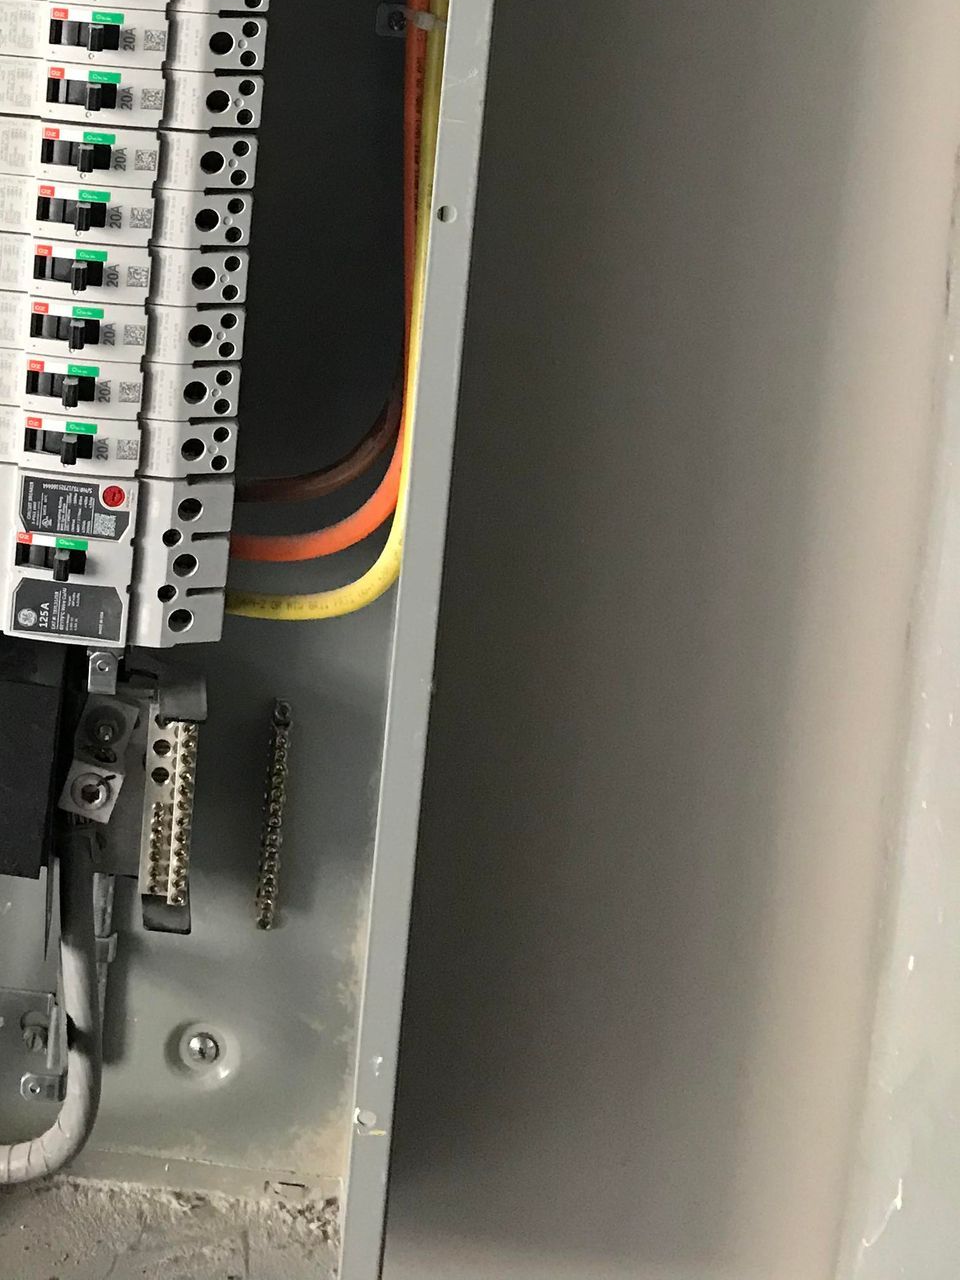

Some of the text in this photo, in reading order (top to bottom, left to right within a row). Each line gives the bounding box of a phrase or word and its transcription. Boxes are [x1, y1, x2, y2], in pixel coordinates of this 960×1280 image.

[121, 28, 136, 52] 20A
[119, 87, 133, 111] 20A
[112, 147, 127, 171] 20A
[107, 206, 122, 229] 20A
[103, 265, 119, 288] 20A
[100, 323, 116, 346] 20A
[95, 380, 111, 404] 20A
[92, 437, 109, 461] 20A
[39, 602, 50, 628] 125A
